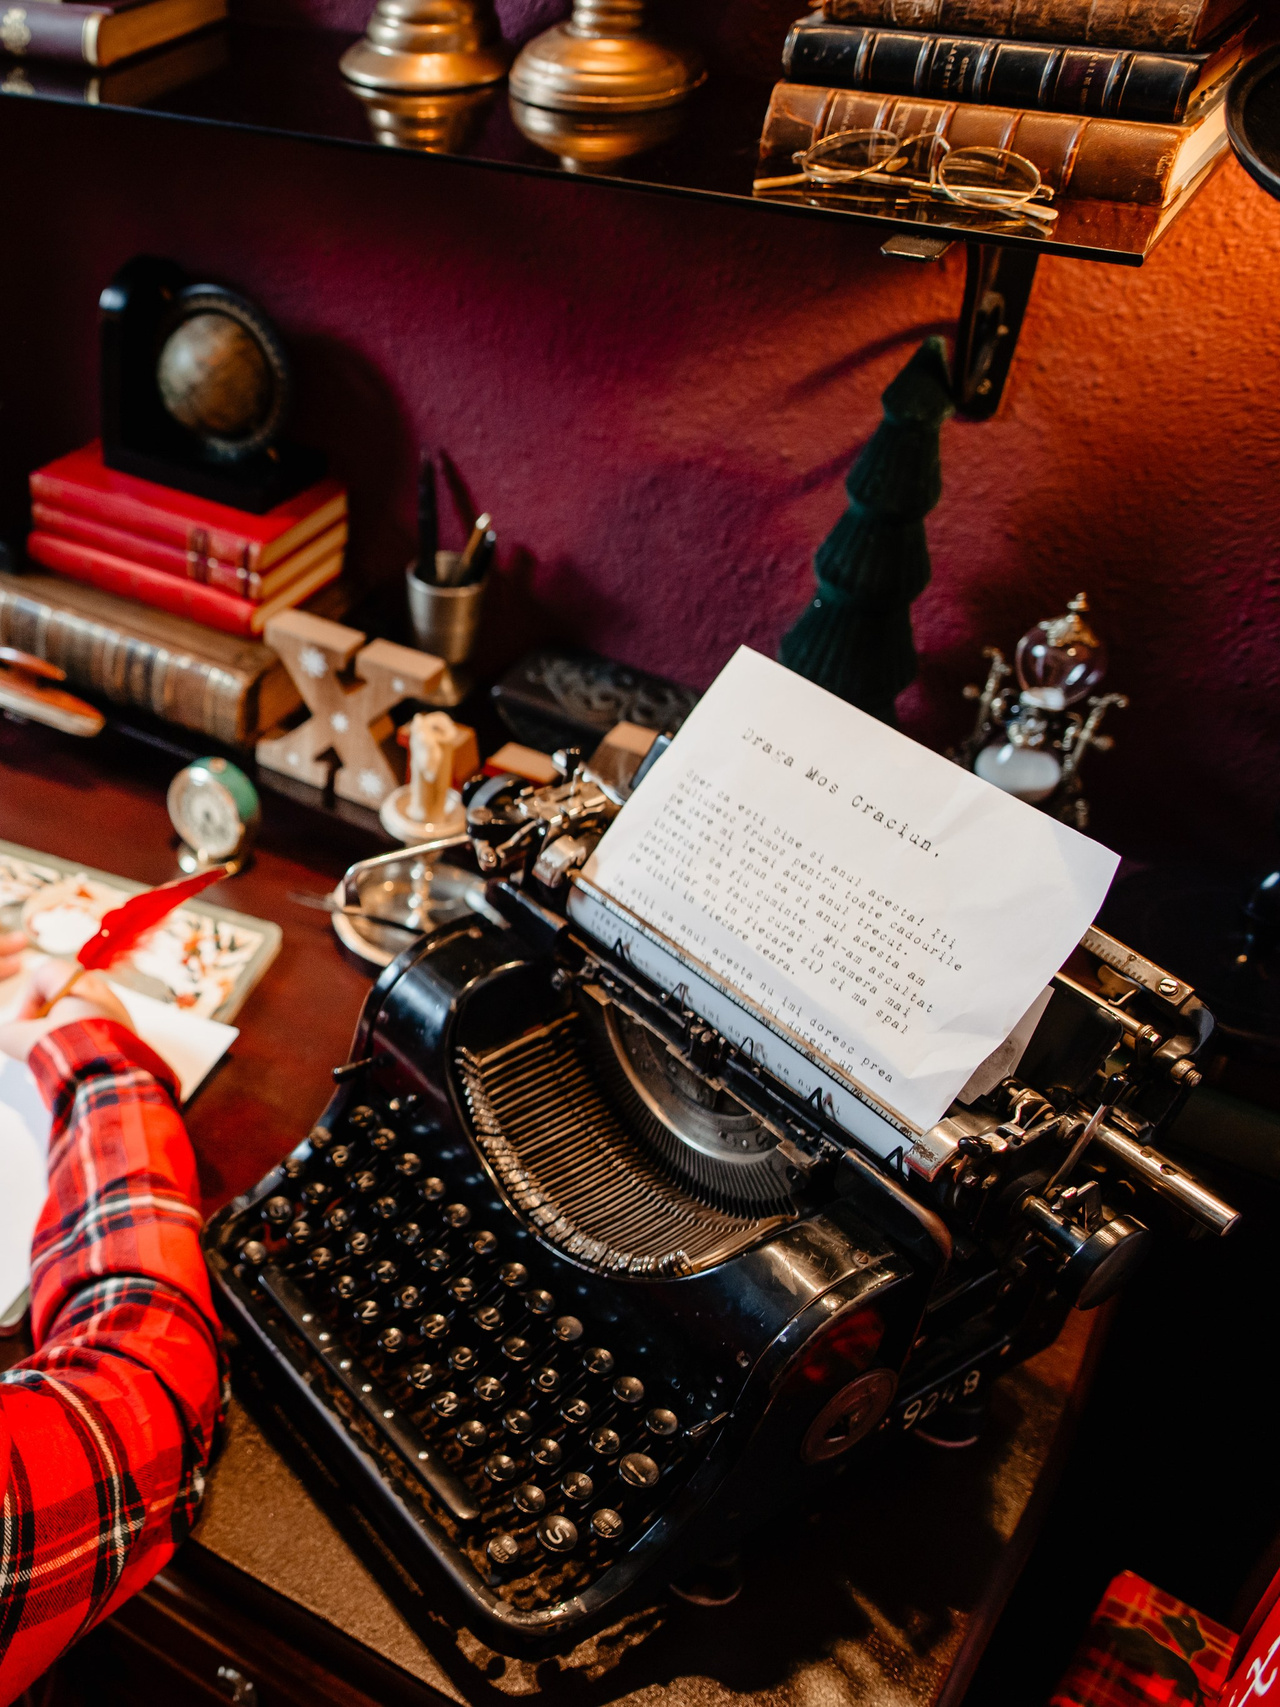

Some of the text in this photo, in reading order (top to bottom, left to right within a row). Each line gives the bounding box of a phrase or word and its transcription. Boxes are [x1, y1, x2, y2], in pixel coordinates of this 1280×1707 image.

[256, 609, 446, 811] X
[741, 727, 794, 768] Draga
[804, 765, 839, 794] Mos
[667, 792, 683, 806] pe
[688, 806, 714, 826] care
[781, 868, 812, 891] adus
[817, 892, 849, 916] anul
[856, 916, 907, 956] trecut.
[682, 889, 695, 904] in
[700, 903, 749, 941] fiecare
[755, 943, 795, 975] seara.
[685, 768, 956, 950] Sper ca esti bine si anul acesta! Iti
[738, 857, 767, 880] spun
[773, 881, 788, 894] ca
[794, 895, 810, 909] si
[814, 909, 847, 932] anul
[852, 934, 900, 969] acesta
[906, 971, 925, 987] am
[742, 823, 786, 856] frumos
[790, 857, 837, 891] pentru
[844, 890, 883, 919] toate
[889, 921, 962, 971] cadourile
[660, 910, 674, 923] ca
[679, 923, 706, 946] anul
[711, 946, 753, 981] acesta
[758, 981, 774, 996] nu
[781, 995, 802, 1018] imi
[808, 1017, 855, 1054] doresc
[861, 1057, 893, 1083] prea
[702, 887, 718, 902] nu
[723, 901, 738, 916] in
[743, 915, 794, 954] fiecare
[799, 955, 824, 974] zi)
[829, 976, 845, 992] si
[850, 991, 867, 1007] ma
[874, 1008, 908, 1035] spal
[704, 872, 720, 886] am
[725, 885, 761, 914] facut
[766, 915, 803, 943] curat
[809, 942, 825, 958] in
[831, 960, 878, 995] camera
[884, 996, 911, 1018] mai
[708, 855, 722, 870] sa
[822, 932, 862, 965] Mi-am
[867, 965, 933, 1013] ascultat
